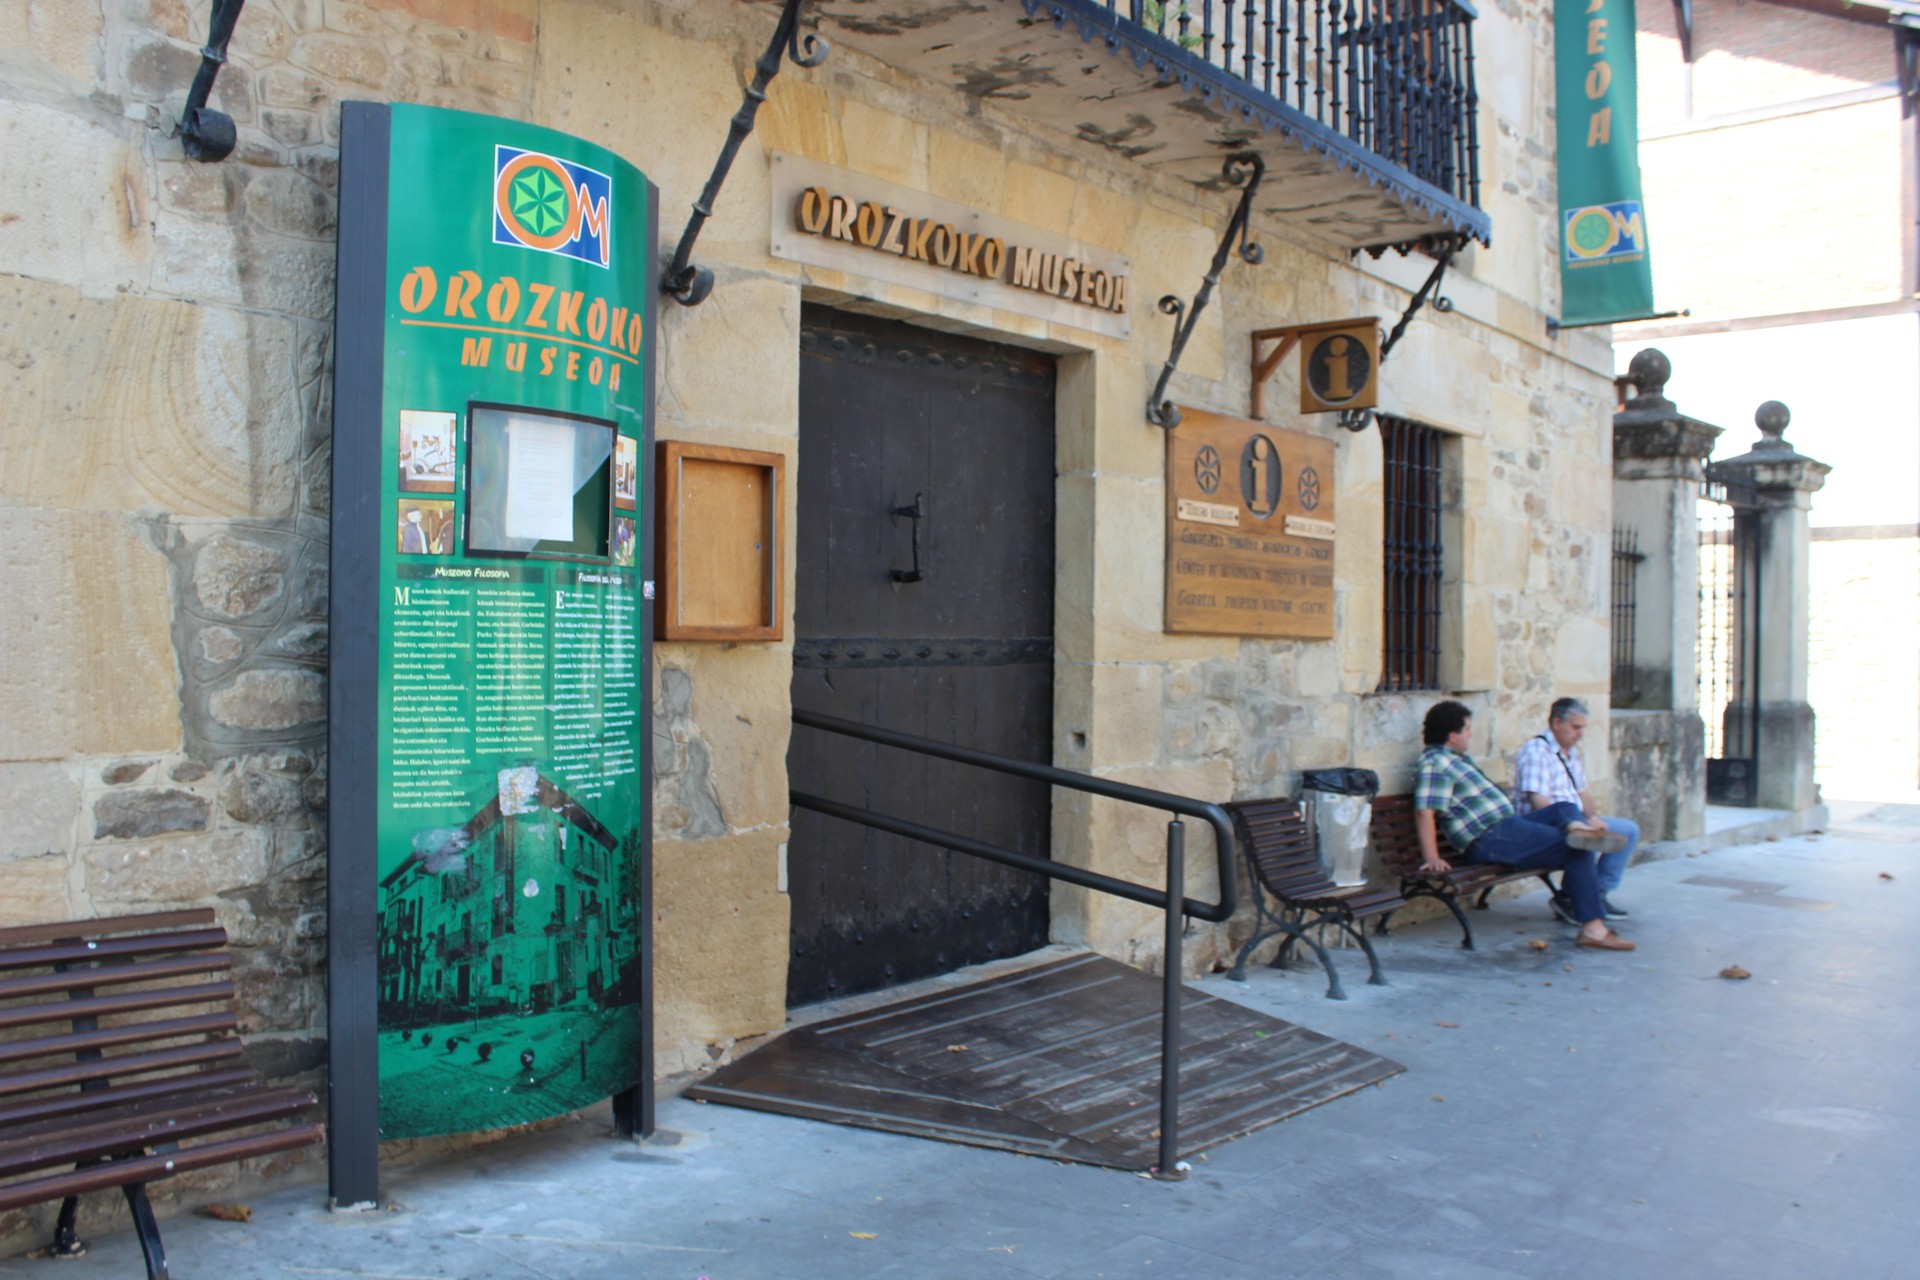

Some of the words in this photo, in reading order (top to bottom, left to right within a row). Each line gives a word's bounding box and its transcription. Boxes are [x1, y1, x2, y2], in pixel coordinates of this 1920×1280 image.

[794, 186, 1006, 279] OROZKOKO
[1007, 245, 1130, 314] MUSEOA
[399, 266, 643, 355] OROZKOKO
[461, 337, 621, 392] MUSEOA
